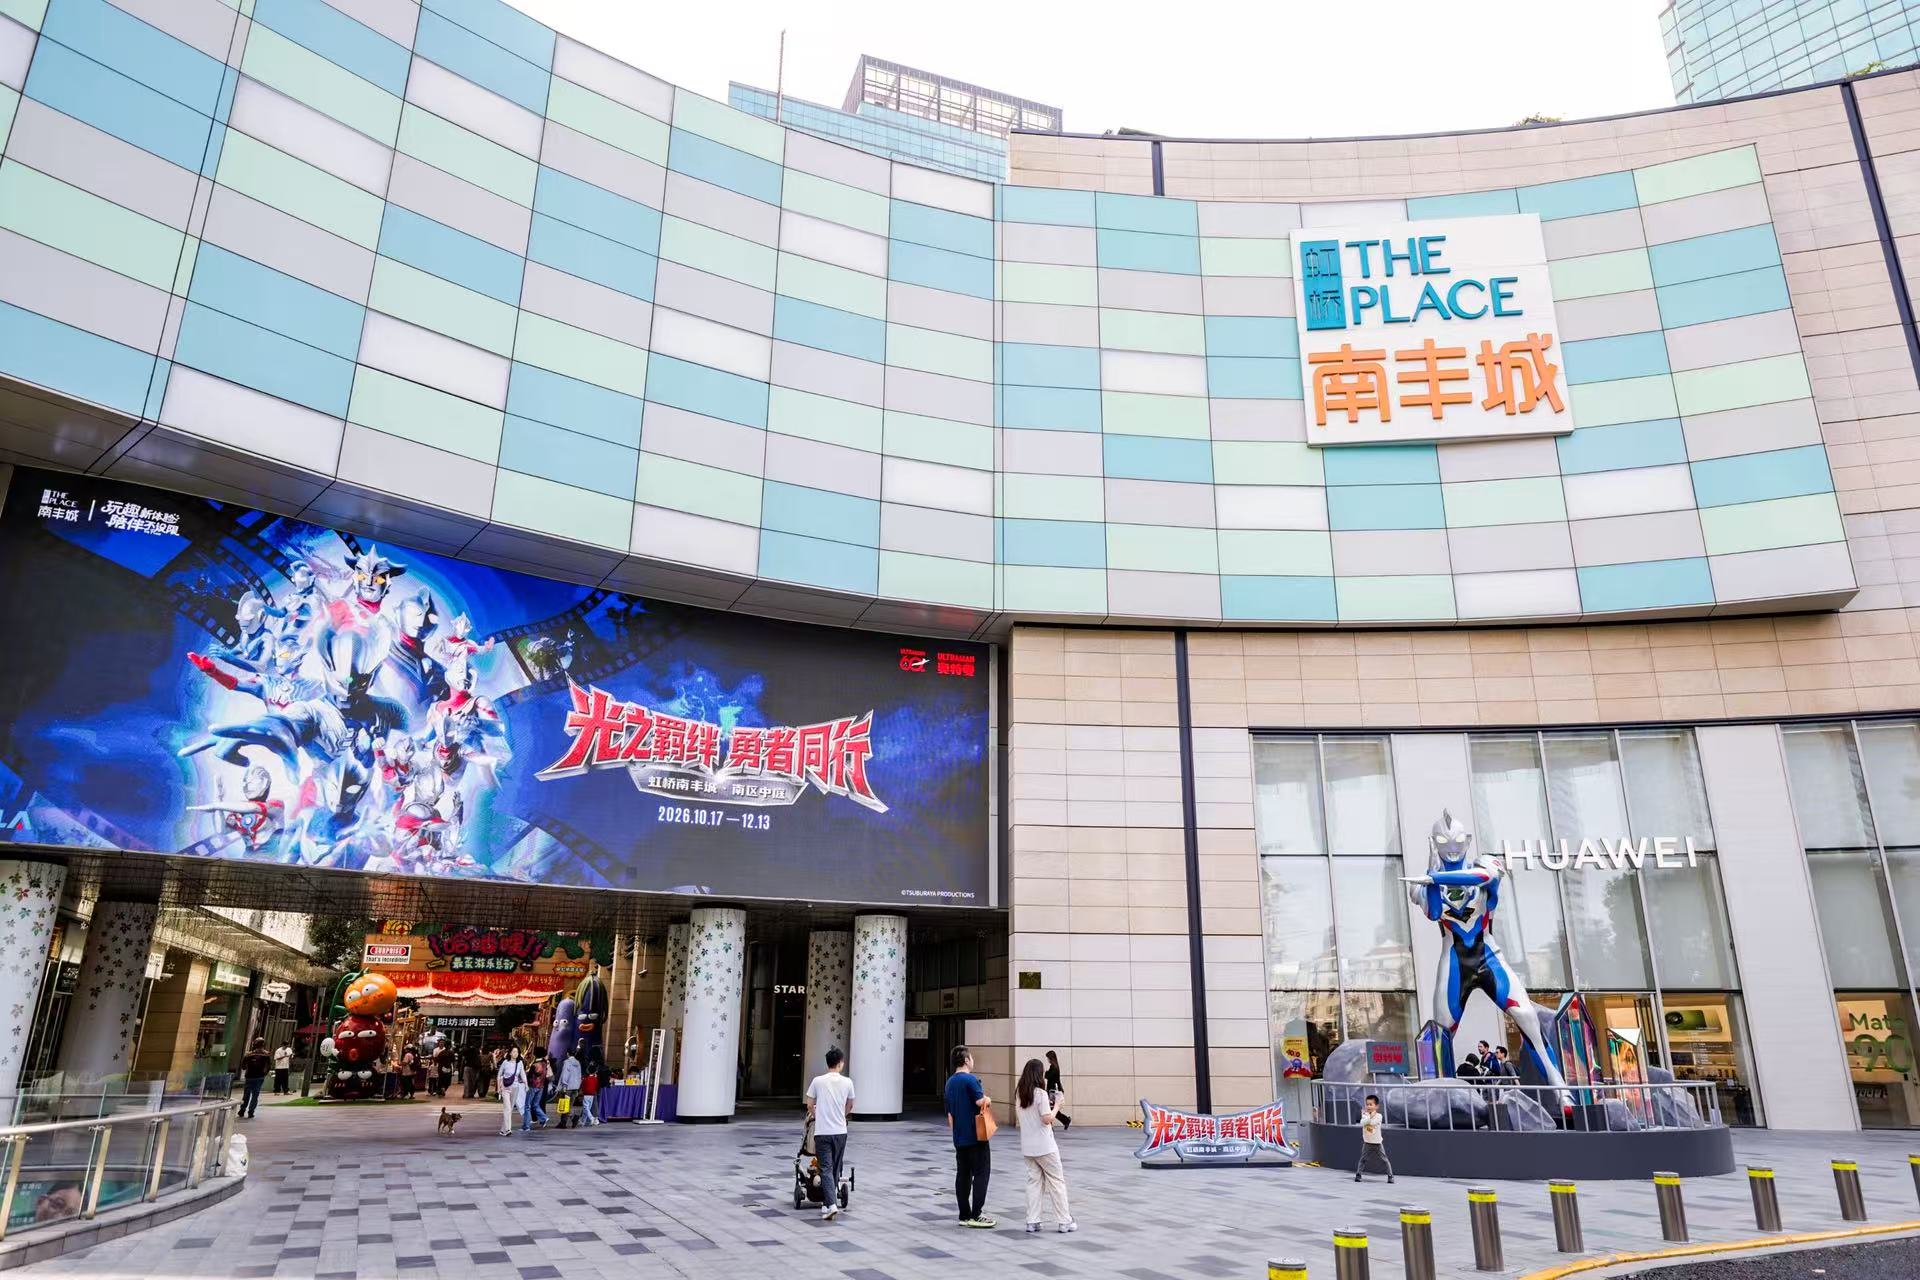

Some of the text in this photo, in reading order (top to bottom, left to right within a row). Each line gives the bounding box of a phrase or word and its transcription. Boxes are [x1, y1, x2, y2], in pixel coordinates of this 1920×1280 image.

[1345, 235, 1451, 278] THE
[1350, 277, 1523, 325] PLACE
[1308, 332, 1565, 426] 南丰城
[37, 505, 79, 522] 南丰城
[1502, 836, 1697, 871] HUAWEI
[773, 985, 808, 994] STAR
[1848, 1012, 1904, 1031] Mate
